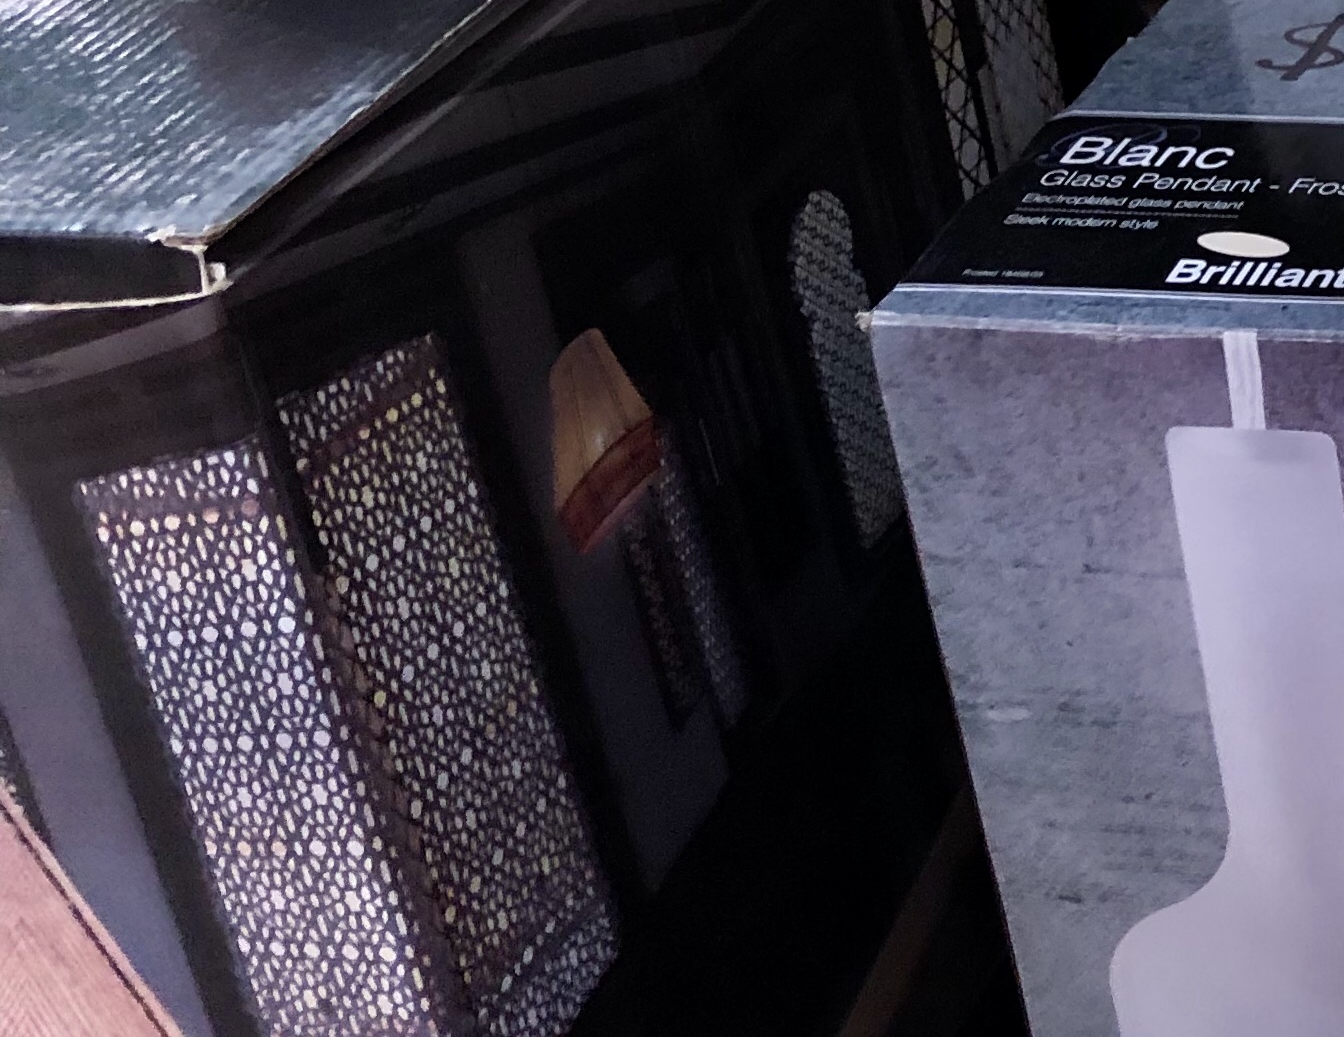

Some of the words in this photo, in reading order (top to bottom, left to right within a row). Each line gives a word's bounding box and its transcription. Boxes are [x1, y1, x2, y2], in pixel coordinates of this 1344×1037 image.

[1059, 136, 1235, 170] Blanc
[1040, 169, 1126, 189] Glass
[1132, 172, 1262, 193] Pendant
[1021, 192, 1128, 207] Electroplated
[1127, 197, 1172, 209] glass
[1173, 199, 1245, 211] pendant
[1003, 213, 1049, 226] Sleek
[1051, 215, 1118, 228] modern
[1118, 218, 1160, 231] style
